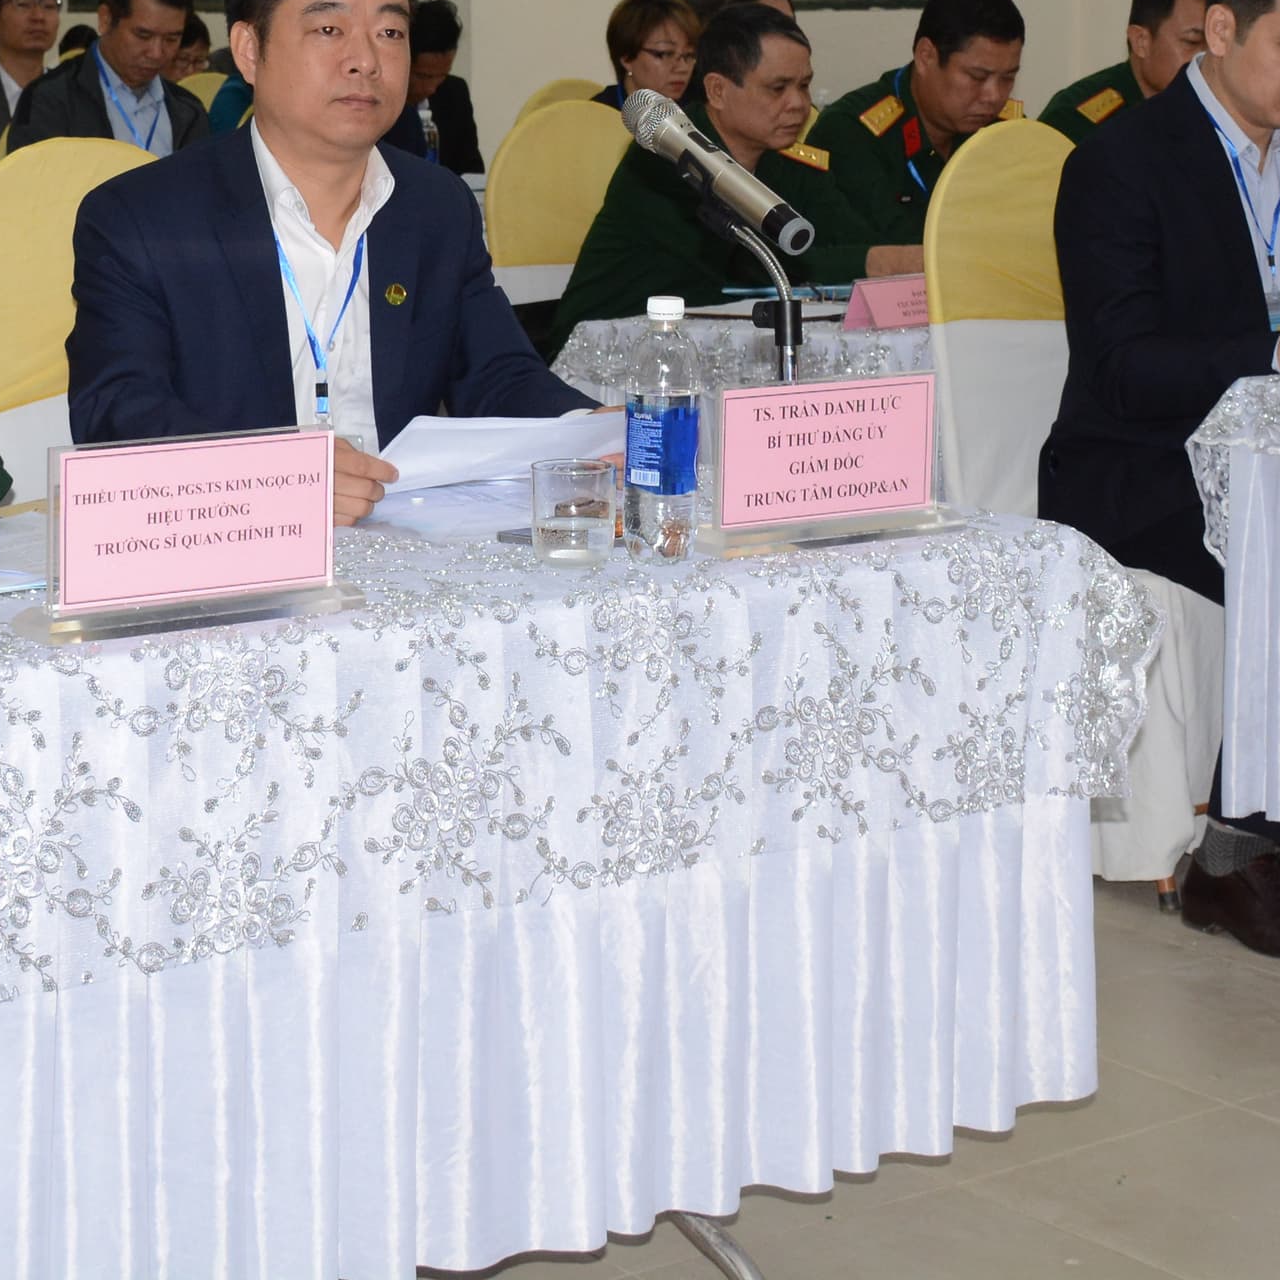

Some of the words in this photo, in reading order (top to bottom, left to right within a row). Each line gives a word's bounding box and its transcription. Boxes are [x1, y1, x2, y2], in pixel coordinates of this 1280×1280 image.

[753, 407, 775, 422] TS.
[824, 398, 866, 416] DANH
[871, 394, 902, 414] LỰC
[768, 430, 782, 449] BÍ
[786, 430, 820, 447] THƯ
[789, 455, 829, 475] GIÁM
[833, 452, 864, 471] ĐỐC
[177, 481, 222, 497] PGS.TS
[226, 479, 252, 492] KIM
[256, 475, 295, 489] NGỌC
[298, 472, 320, 486] ĐẠI
[744, 489, 796, 508] TRUNG
[800, 483, 832, 502] TÂM
[837, 477, 910, 499] GDQP&AN
[147, 508, 183, 526] HIỆU
[187, 502, 251, 521] TRƯỞNG
[95, 536, 160, 556] TRƯỜNG
[164, 533, 177, 549] SĨ
[182, 531, 222, 550] QUAN
[227, 525, 274, 543] CHÍNH
[279, 523, 302, 539] TRỊ
